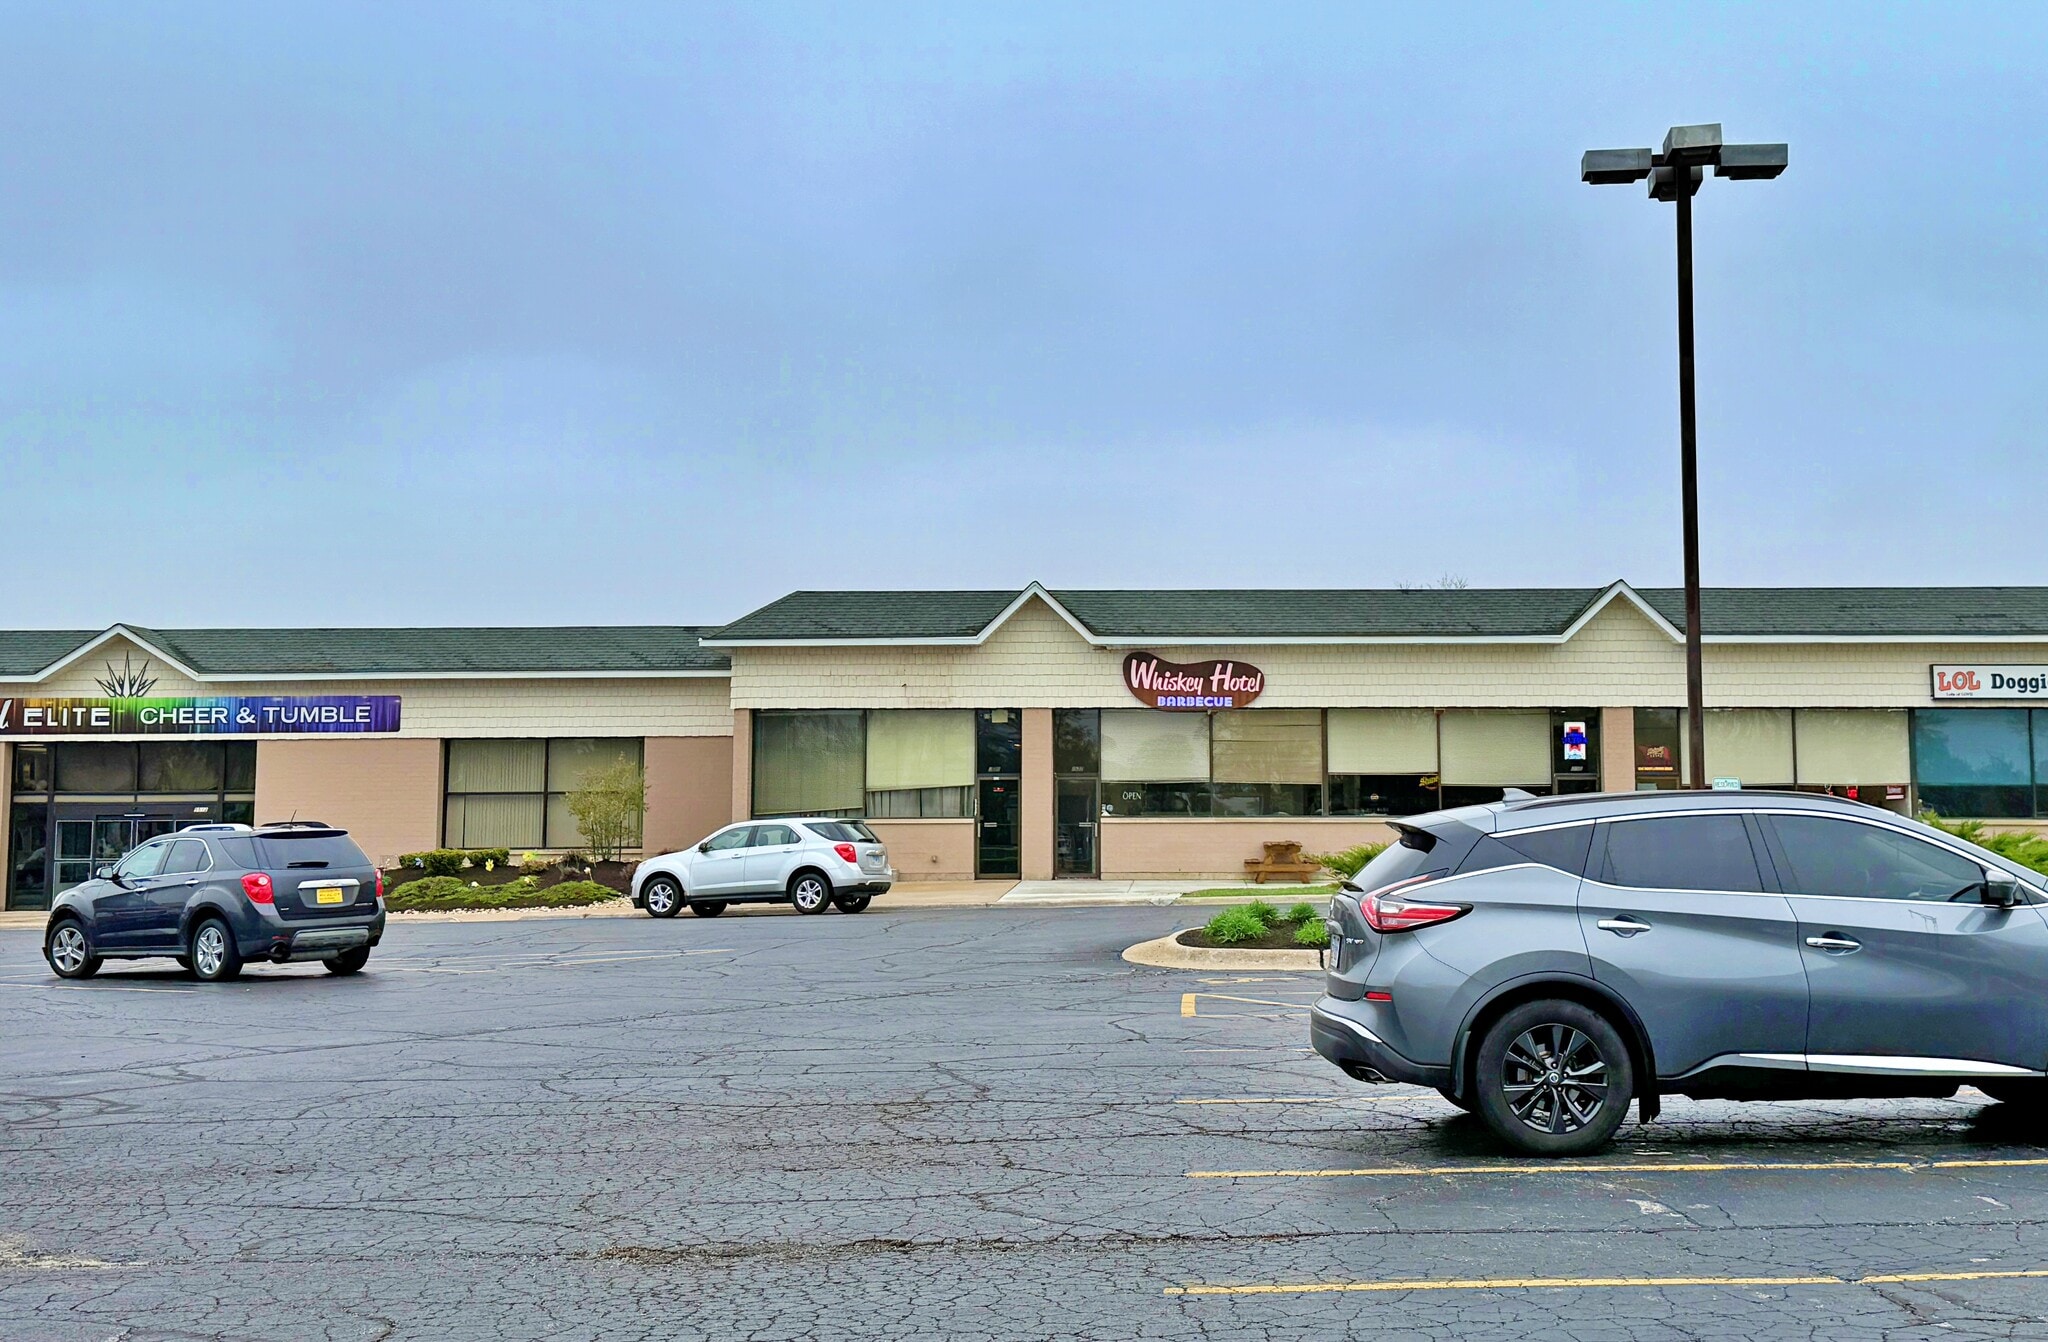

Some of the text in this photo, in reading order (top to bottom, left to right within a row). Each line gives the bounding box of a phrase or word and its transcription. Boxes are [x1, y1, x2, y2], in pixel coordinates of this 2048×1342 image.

[1130, 658, 1262, 695] Whiskey Hotel
[1937, 670, 2048, 693] LOL Doggi
[1157, 695, 1233, 707] BARBECUE
[23, 707, 110, 727] ELITE
[139, 707, 228, 725] CHEER
[235, 706, 256, 724] &
[262, 706, 371, 724] TUMBLE
[1122, 791, 1142, 800] OPEN
